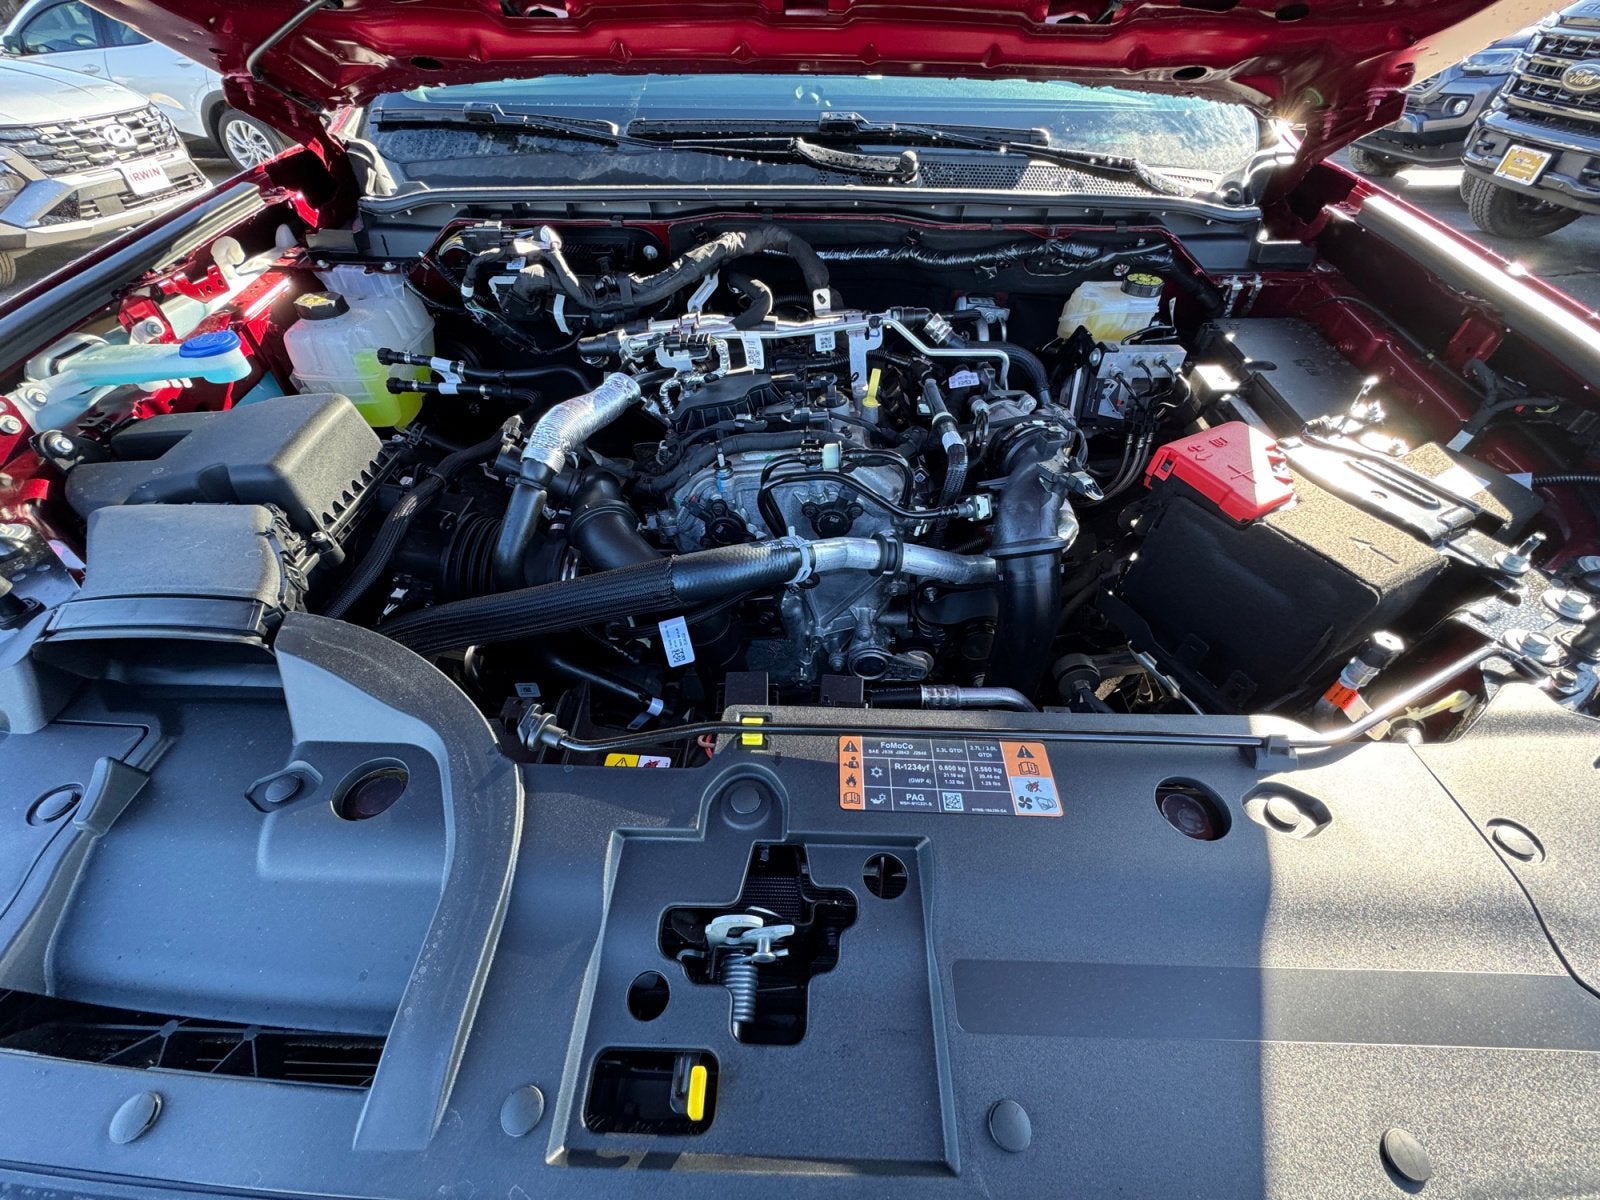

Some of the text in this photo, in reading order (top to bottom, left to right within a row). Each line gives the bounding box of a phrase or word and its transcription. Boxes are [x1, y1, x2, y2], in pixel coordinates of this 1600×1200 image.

[128, 167, 161, 182] IRWIN
[880, 741, 914, 750] FoMoCo
[894, 762, 930, 773] R-1234yf
[957, 765, 966, 773] kg
[905, 793, 925, 801] PAG
